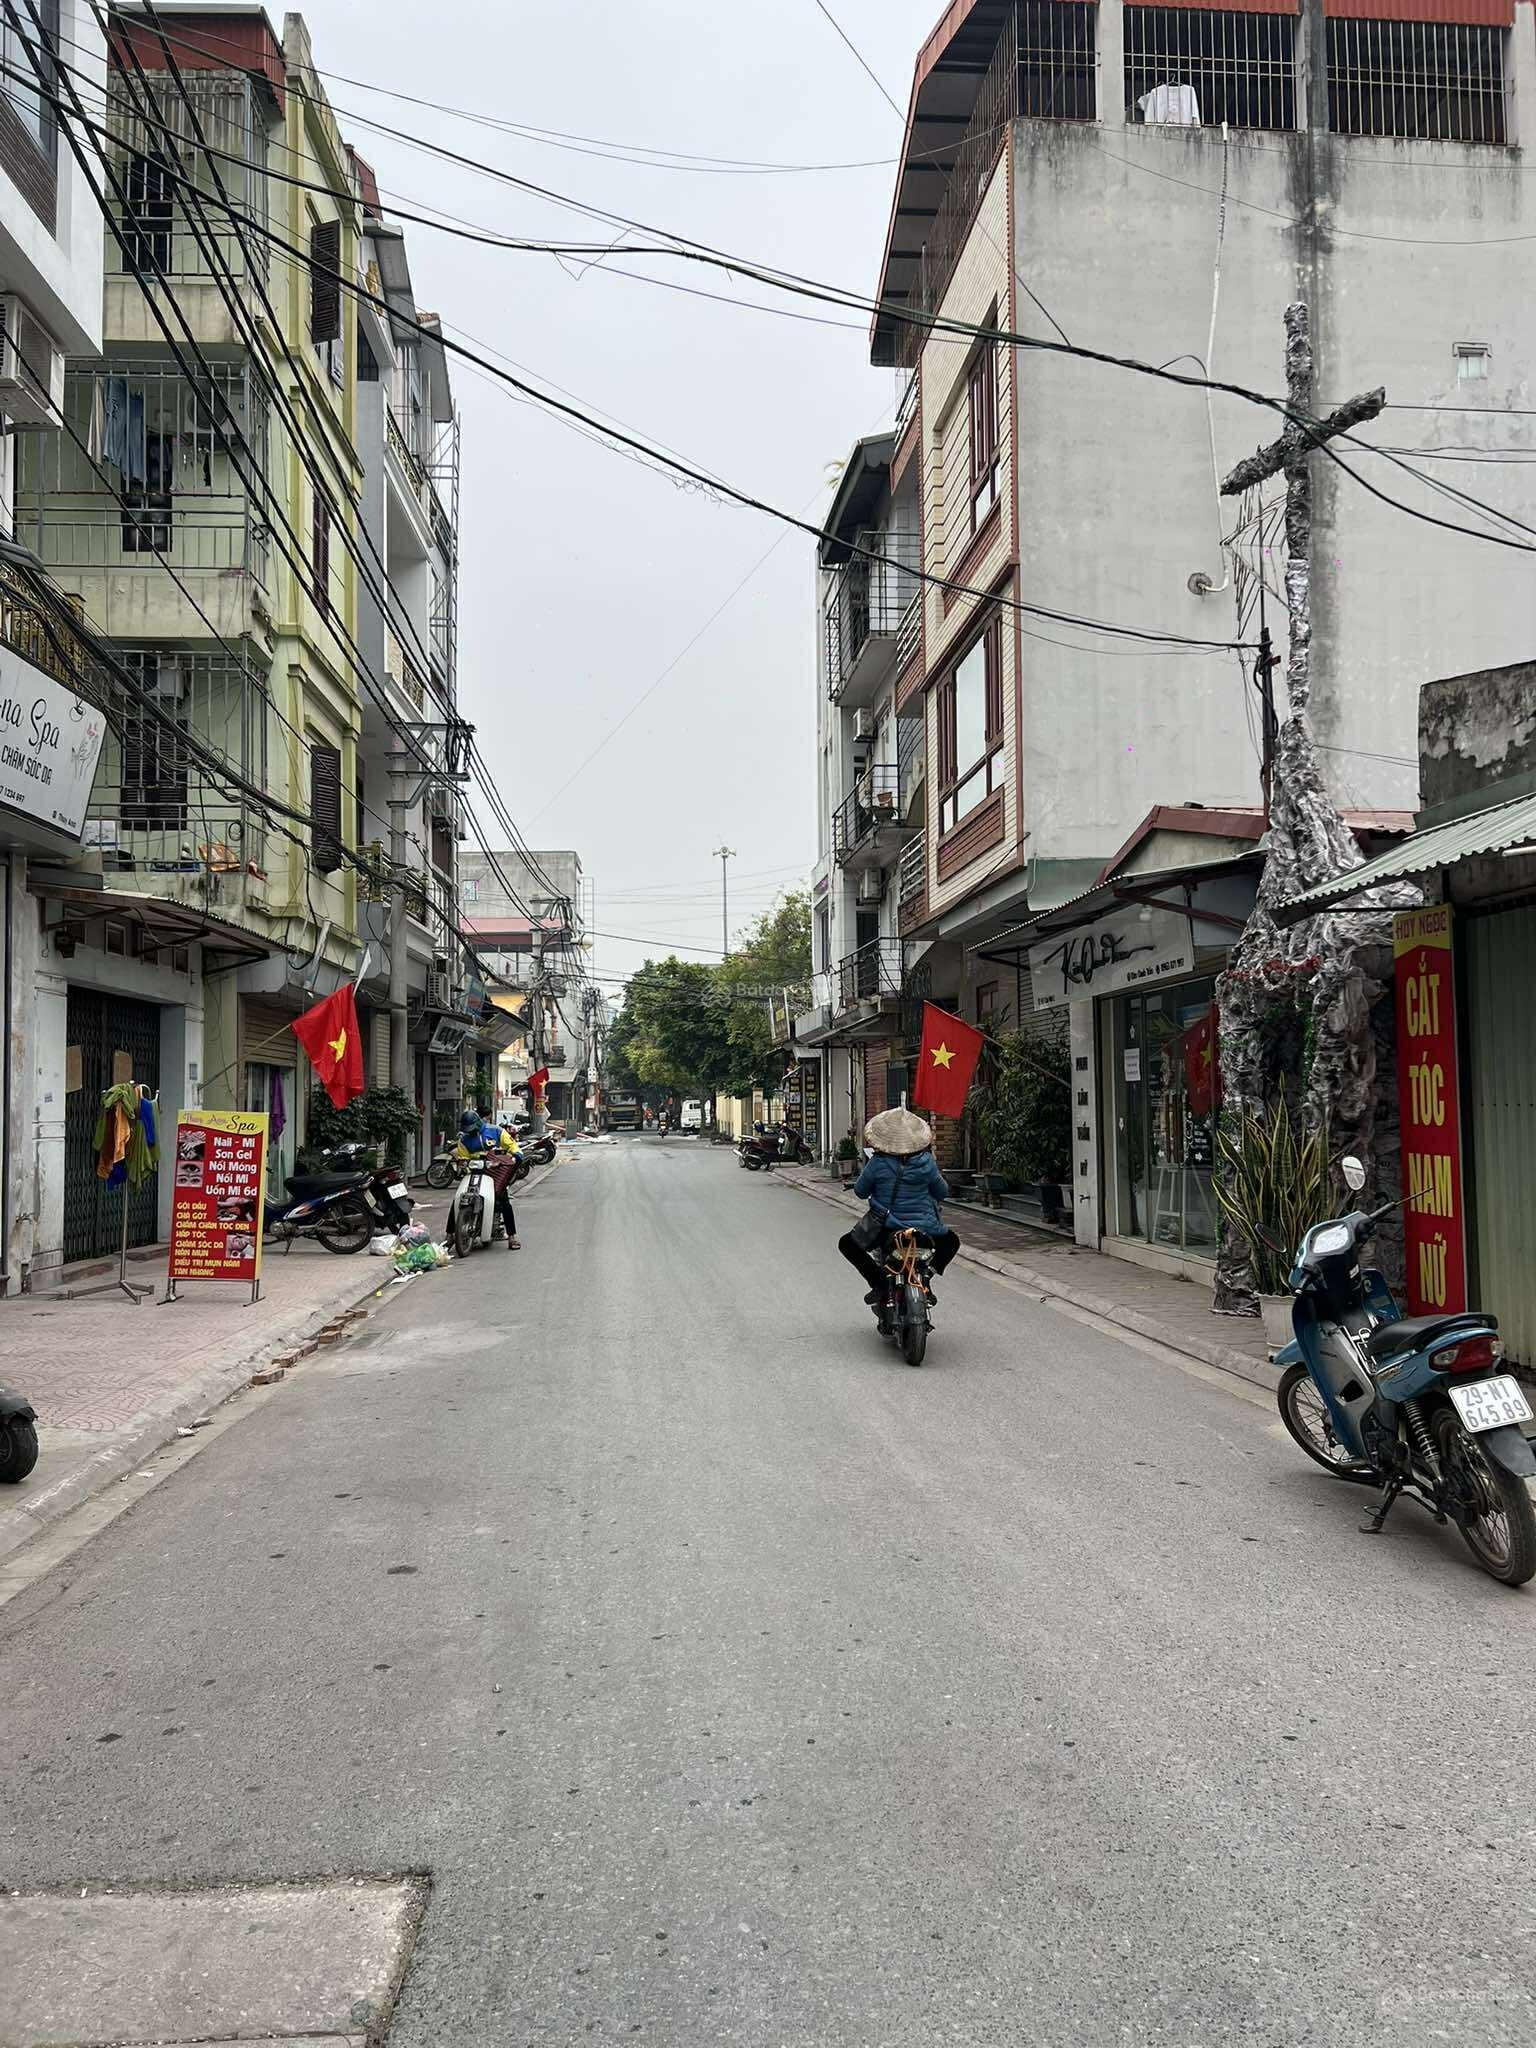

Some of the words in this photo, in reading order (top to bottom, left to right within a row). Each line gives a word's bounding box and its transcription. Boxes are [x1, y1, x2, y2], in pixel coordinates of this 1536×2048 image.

[28, 698, 62, 755] Spa
[1405, 951, 1441, 1037] CẮT
[1408, 1051, 1446, 1127] TÓC
[226, 1114, 257, 1134] Spa
[213, 1137, 232, 1147] Nail
[242, 1137, 255, 1148] Mi
[236, 1150, 252, 1159] Gel
[228, 1161, 257, 1174] Móng
[235, 1174, 249, 1184] Mi
[227, 1186, 241, 1195] Mi
[1408, 1153, 1454, 1218] NAM
[1419, 1233, 1448, 1308] NỮ
[1461, 1381, 1511, 1407] 29-N1
[1466, 1399, 1526, 1428] 645.89
